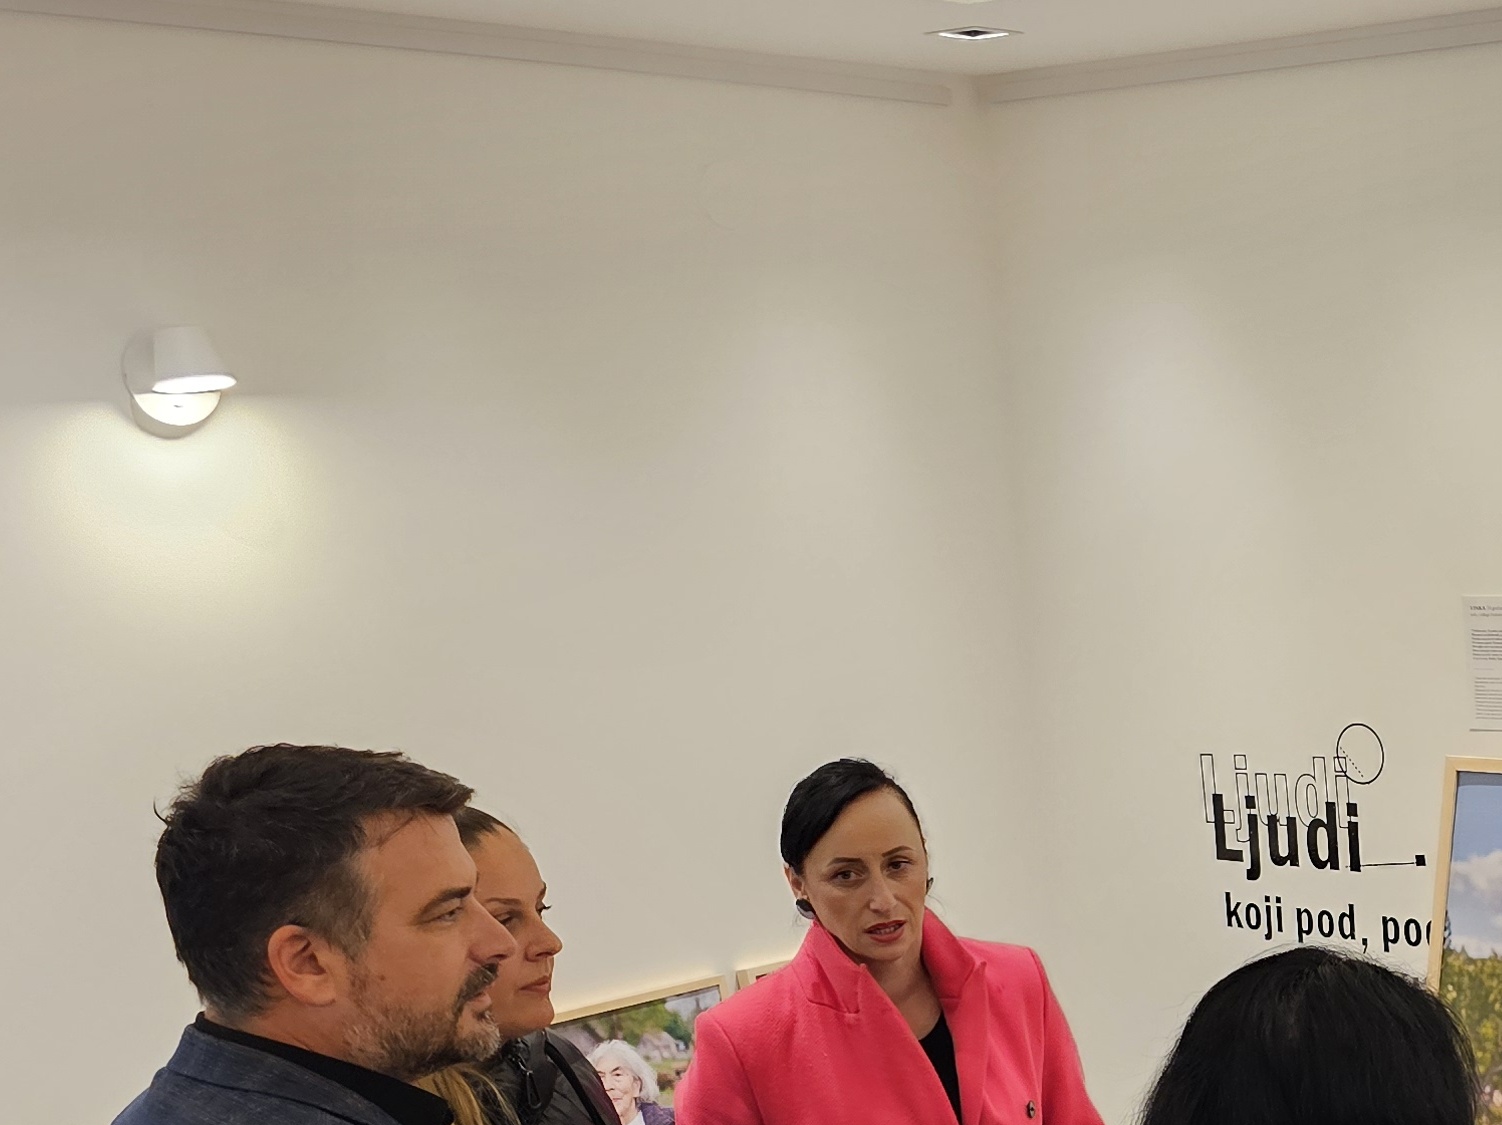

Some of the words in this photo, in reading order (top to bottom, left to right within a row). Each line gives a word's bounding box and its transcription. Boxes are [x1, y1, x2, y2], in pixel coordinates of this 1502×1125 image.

[1200, 753, 1350, 842] Ljudi
[1212, 793, 1361, 881] Ljudi
[1225, 891, 1283, 940] koji
